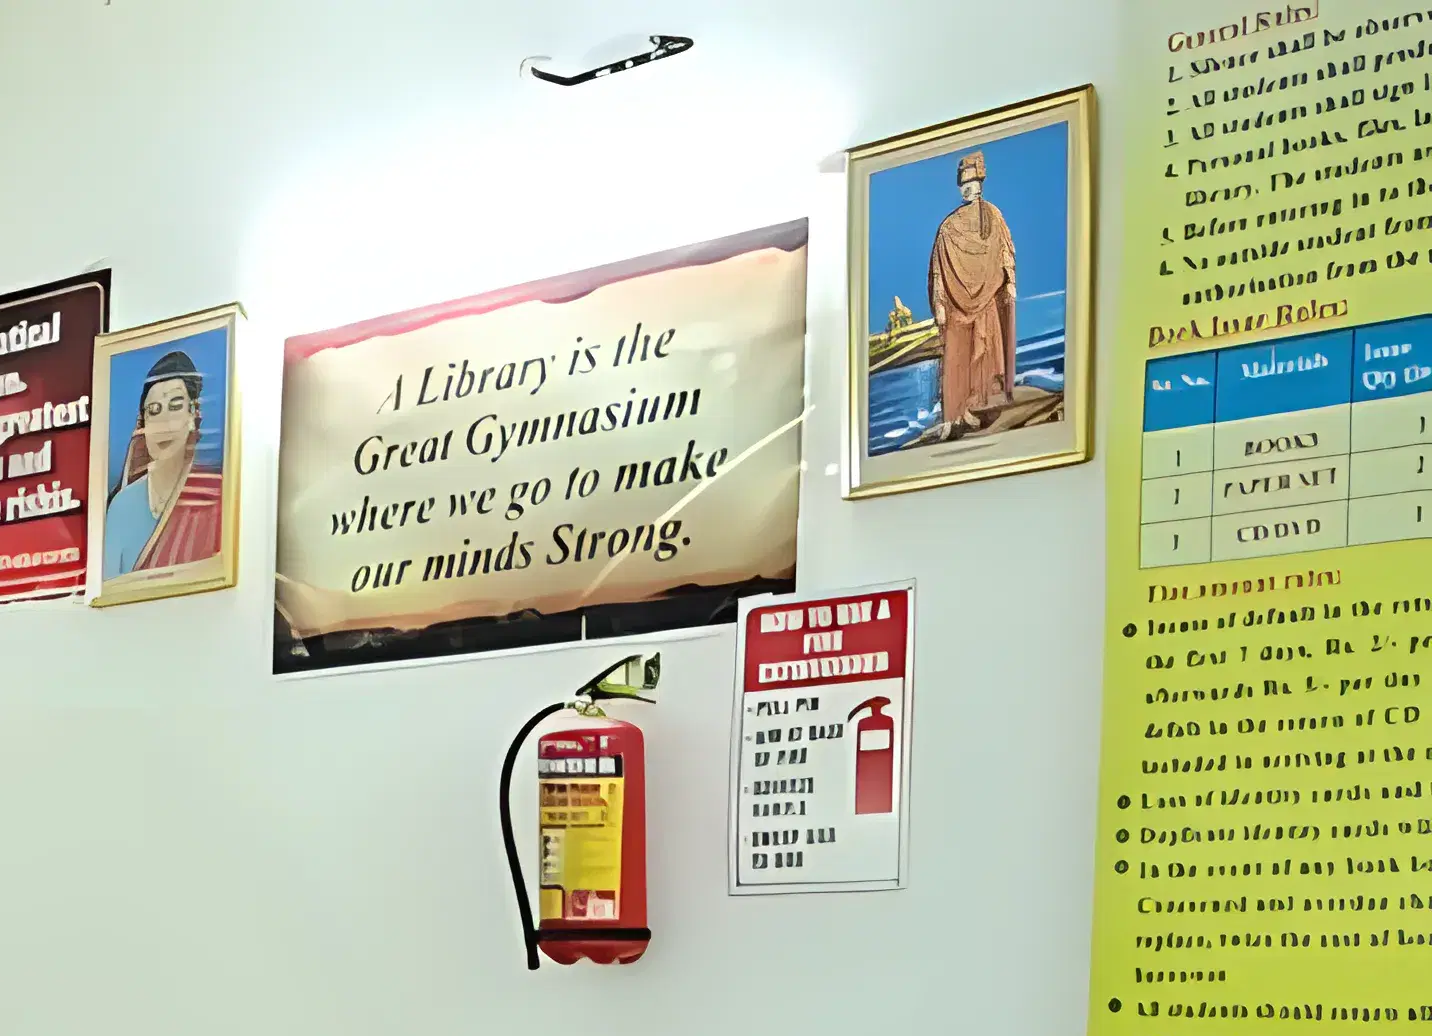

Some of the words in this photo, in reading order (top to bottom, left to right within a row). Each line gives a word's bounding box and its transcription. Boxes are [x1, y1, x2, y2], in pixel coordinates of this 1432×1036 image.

[377, 374, 404, 414] A
[417, 353, 555, 406] Library
[568, 336, 600, 376] is
[613, 322, 676, 367] the
[354, 430, 454, 476] Great
[465, 387, 702, 464] Gymnasium
[331, 495, 435, 537] where
[449, 485, 496, 518] we
[504, 477, 551, 520] go
[565, 467, 599, 501] to
[614, 440, 729, 493] make
[351, 557, 412, 594] our
[422, 531, 534, 582] minds
[546, 518, 692, 567] Strong.
